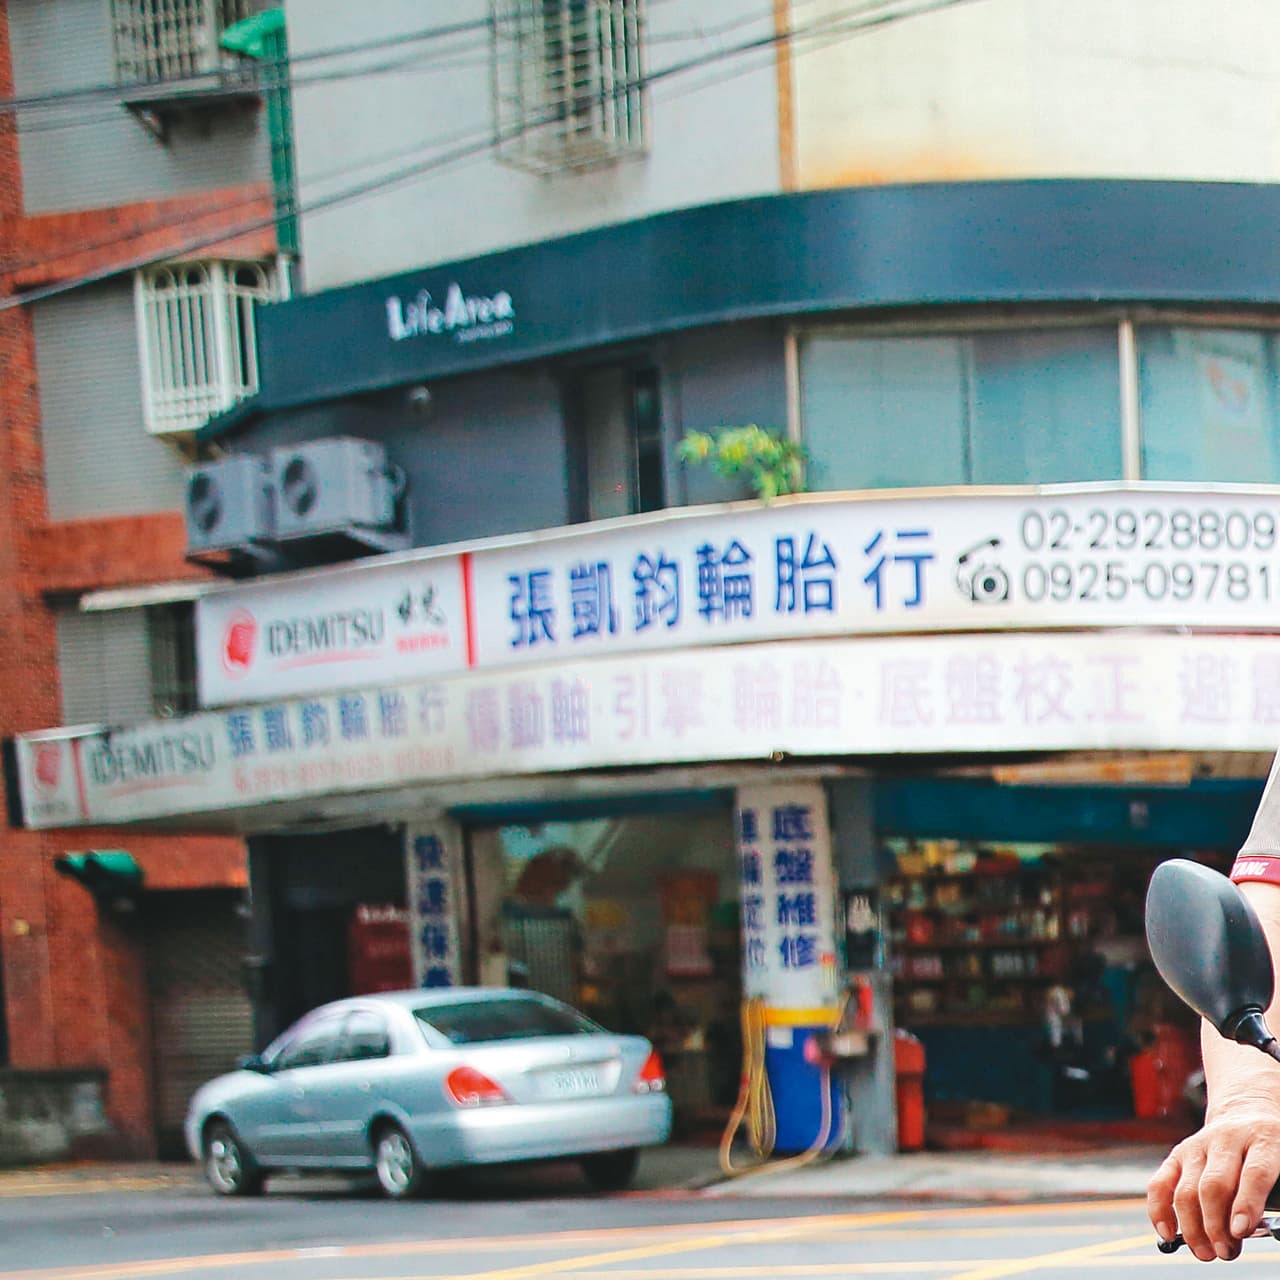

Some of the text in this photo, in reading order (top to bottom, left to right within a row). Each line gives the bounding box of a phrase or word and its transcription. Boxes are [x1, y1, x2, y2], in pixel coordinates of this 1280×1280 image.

[268, 608, 387, 657] IDEMITSU
[877, 650, 1145, 729] 底盤校正
[92, 731, 217, 785] IDEMITSU
